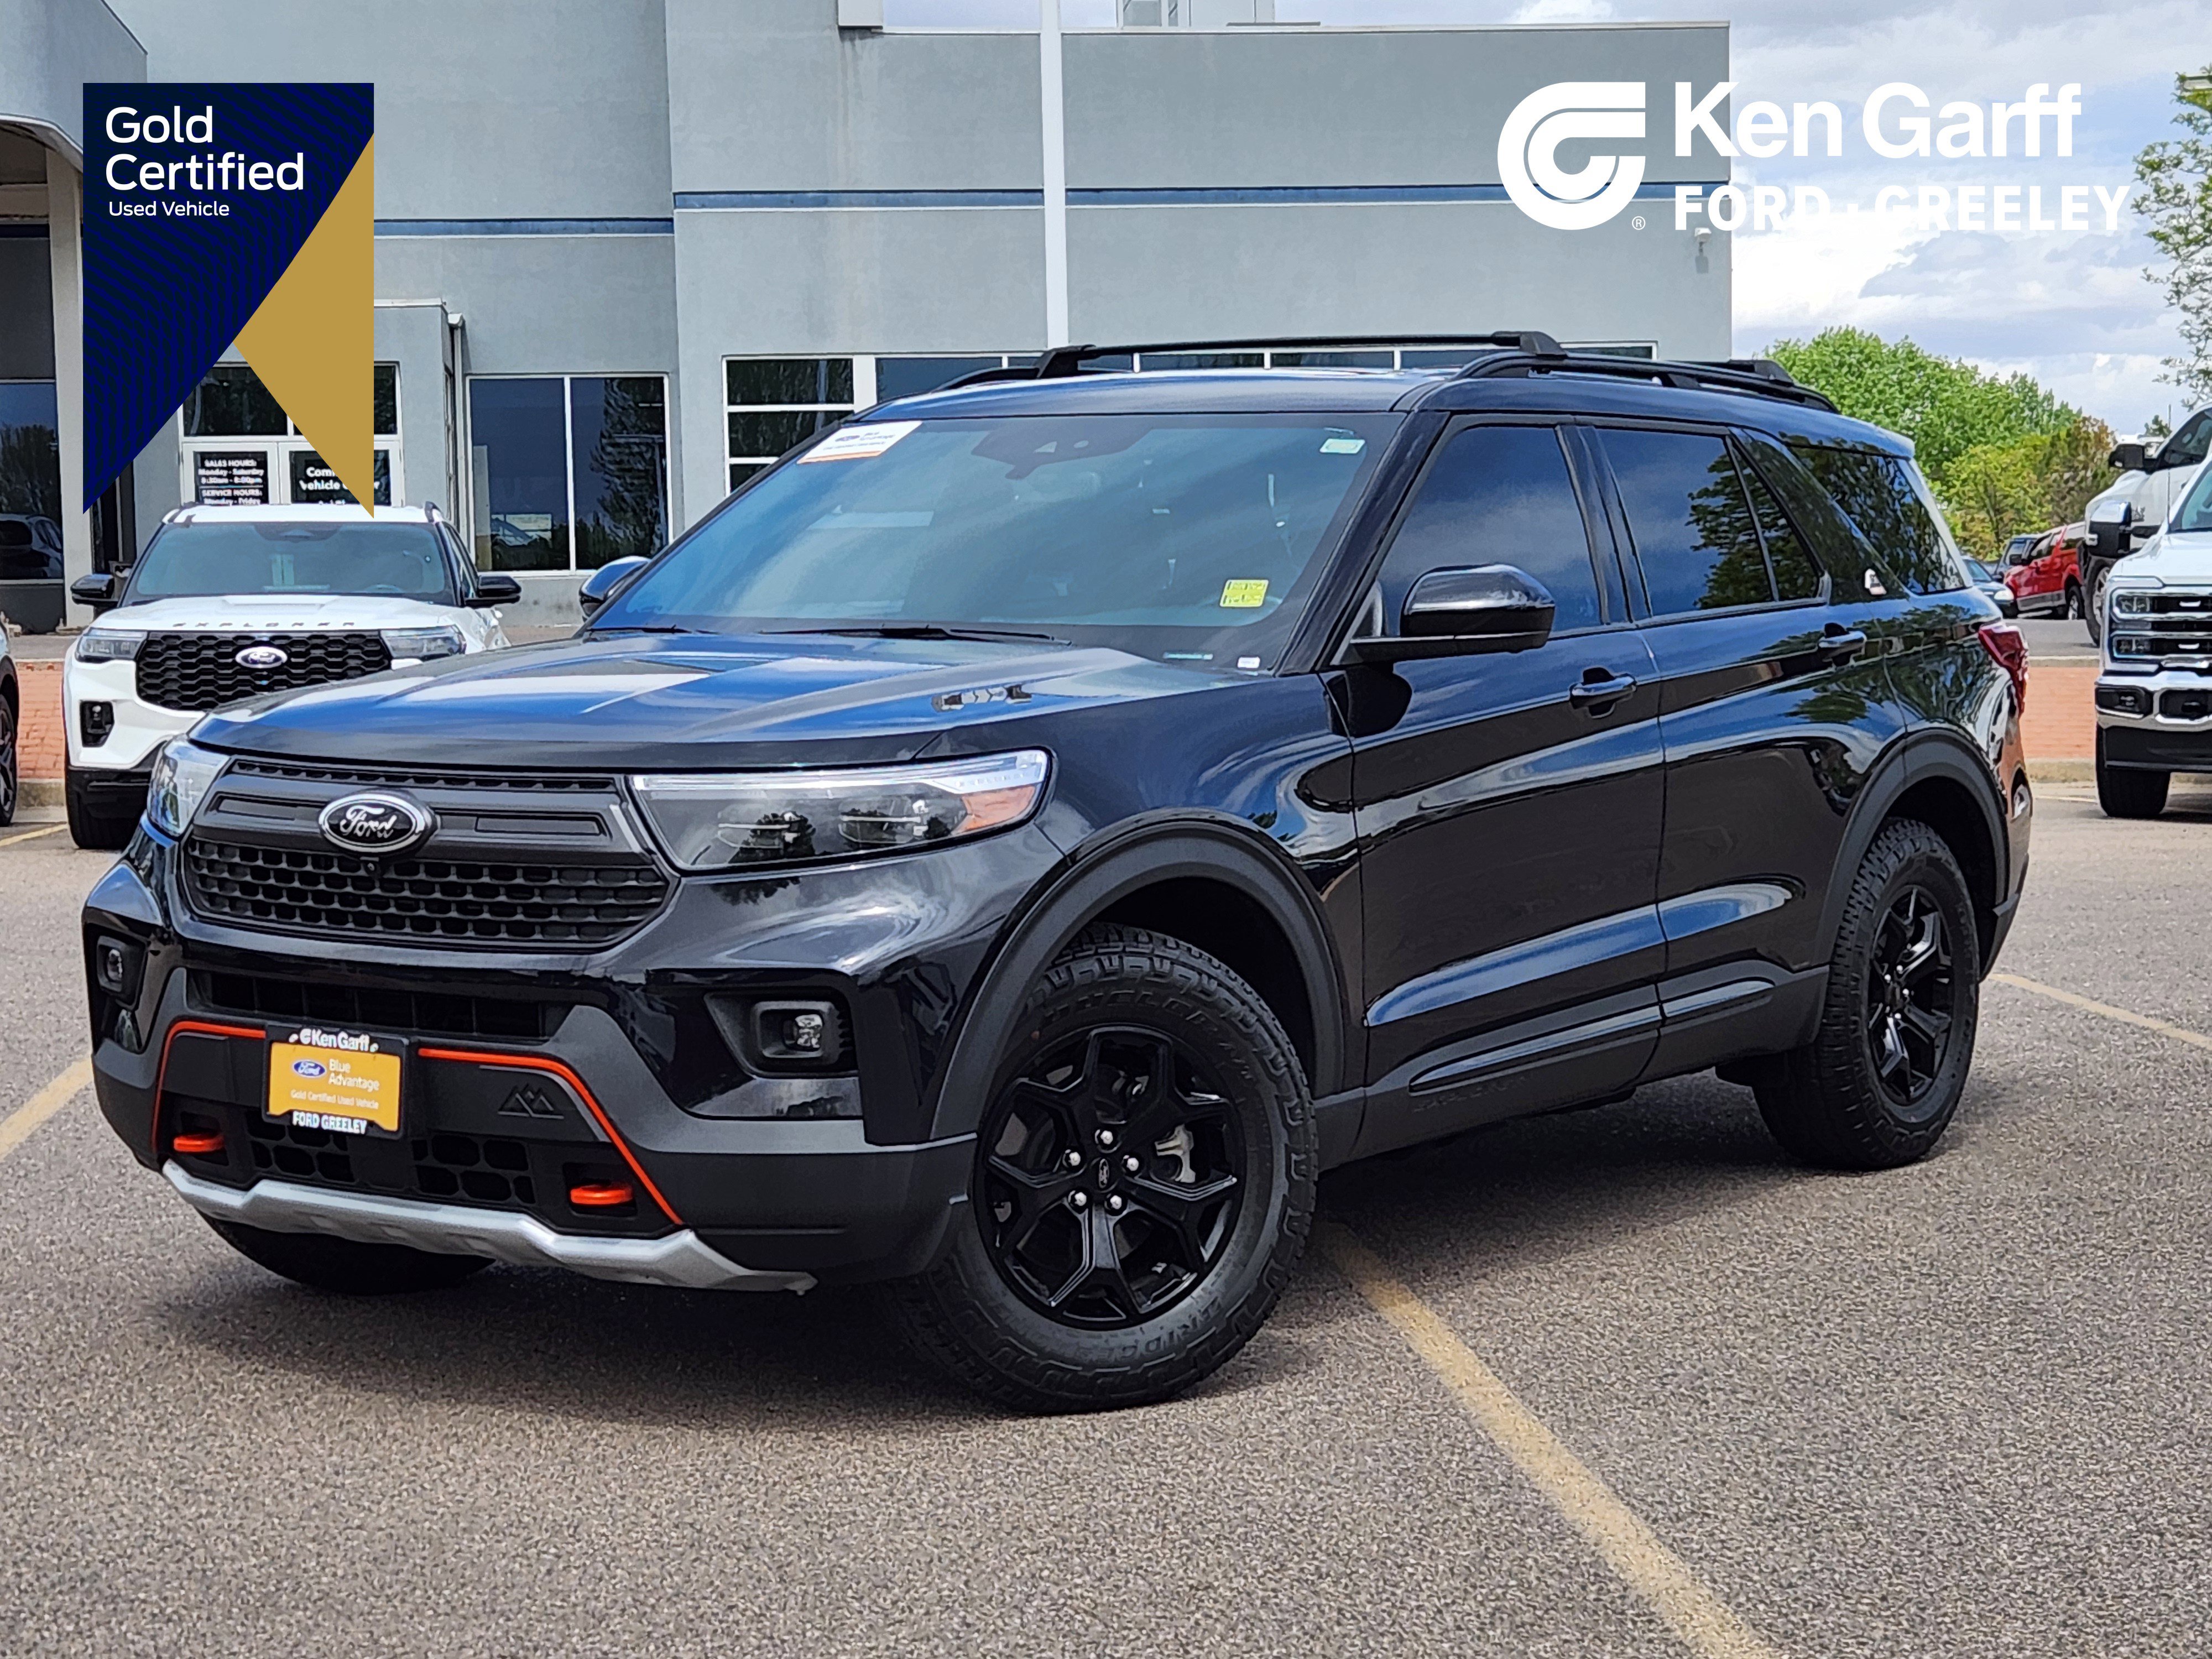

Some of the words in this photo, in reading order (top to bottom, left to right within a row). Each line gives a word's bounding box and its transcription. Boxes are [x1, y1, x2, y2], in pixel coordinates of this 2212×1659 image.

[198, 468, 228, 477] Monday
[299, 479, 341, 491] Vehicle
[340, 805, 398, 839] Ford
[311, 1028, 337, 1048] Ken
[337, 1031, 370, 1051] Garff
[298, 1061, 322, 1076] Ford
[329, 1058, 351, 1073] Blue
[328, 1073, 380, 1092] Advantage
[290, 1089, 307, 1100] Gold
[307, 1091, 337, 1104] Certified
[337, 1094, 355, 1105] Used
[356, 1098, 379, 1110] Vehicle
[293, 1111, 320, 1128] FORD
[321, 1115, 367, 1134] GREELEY
